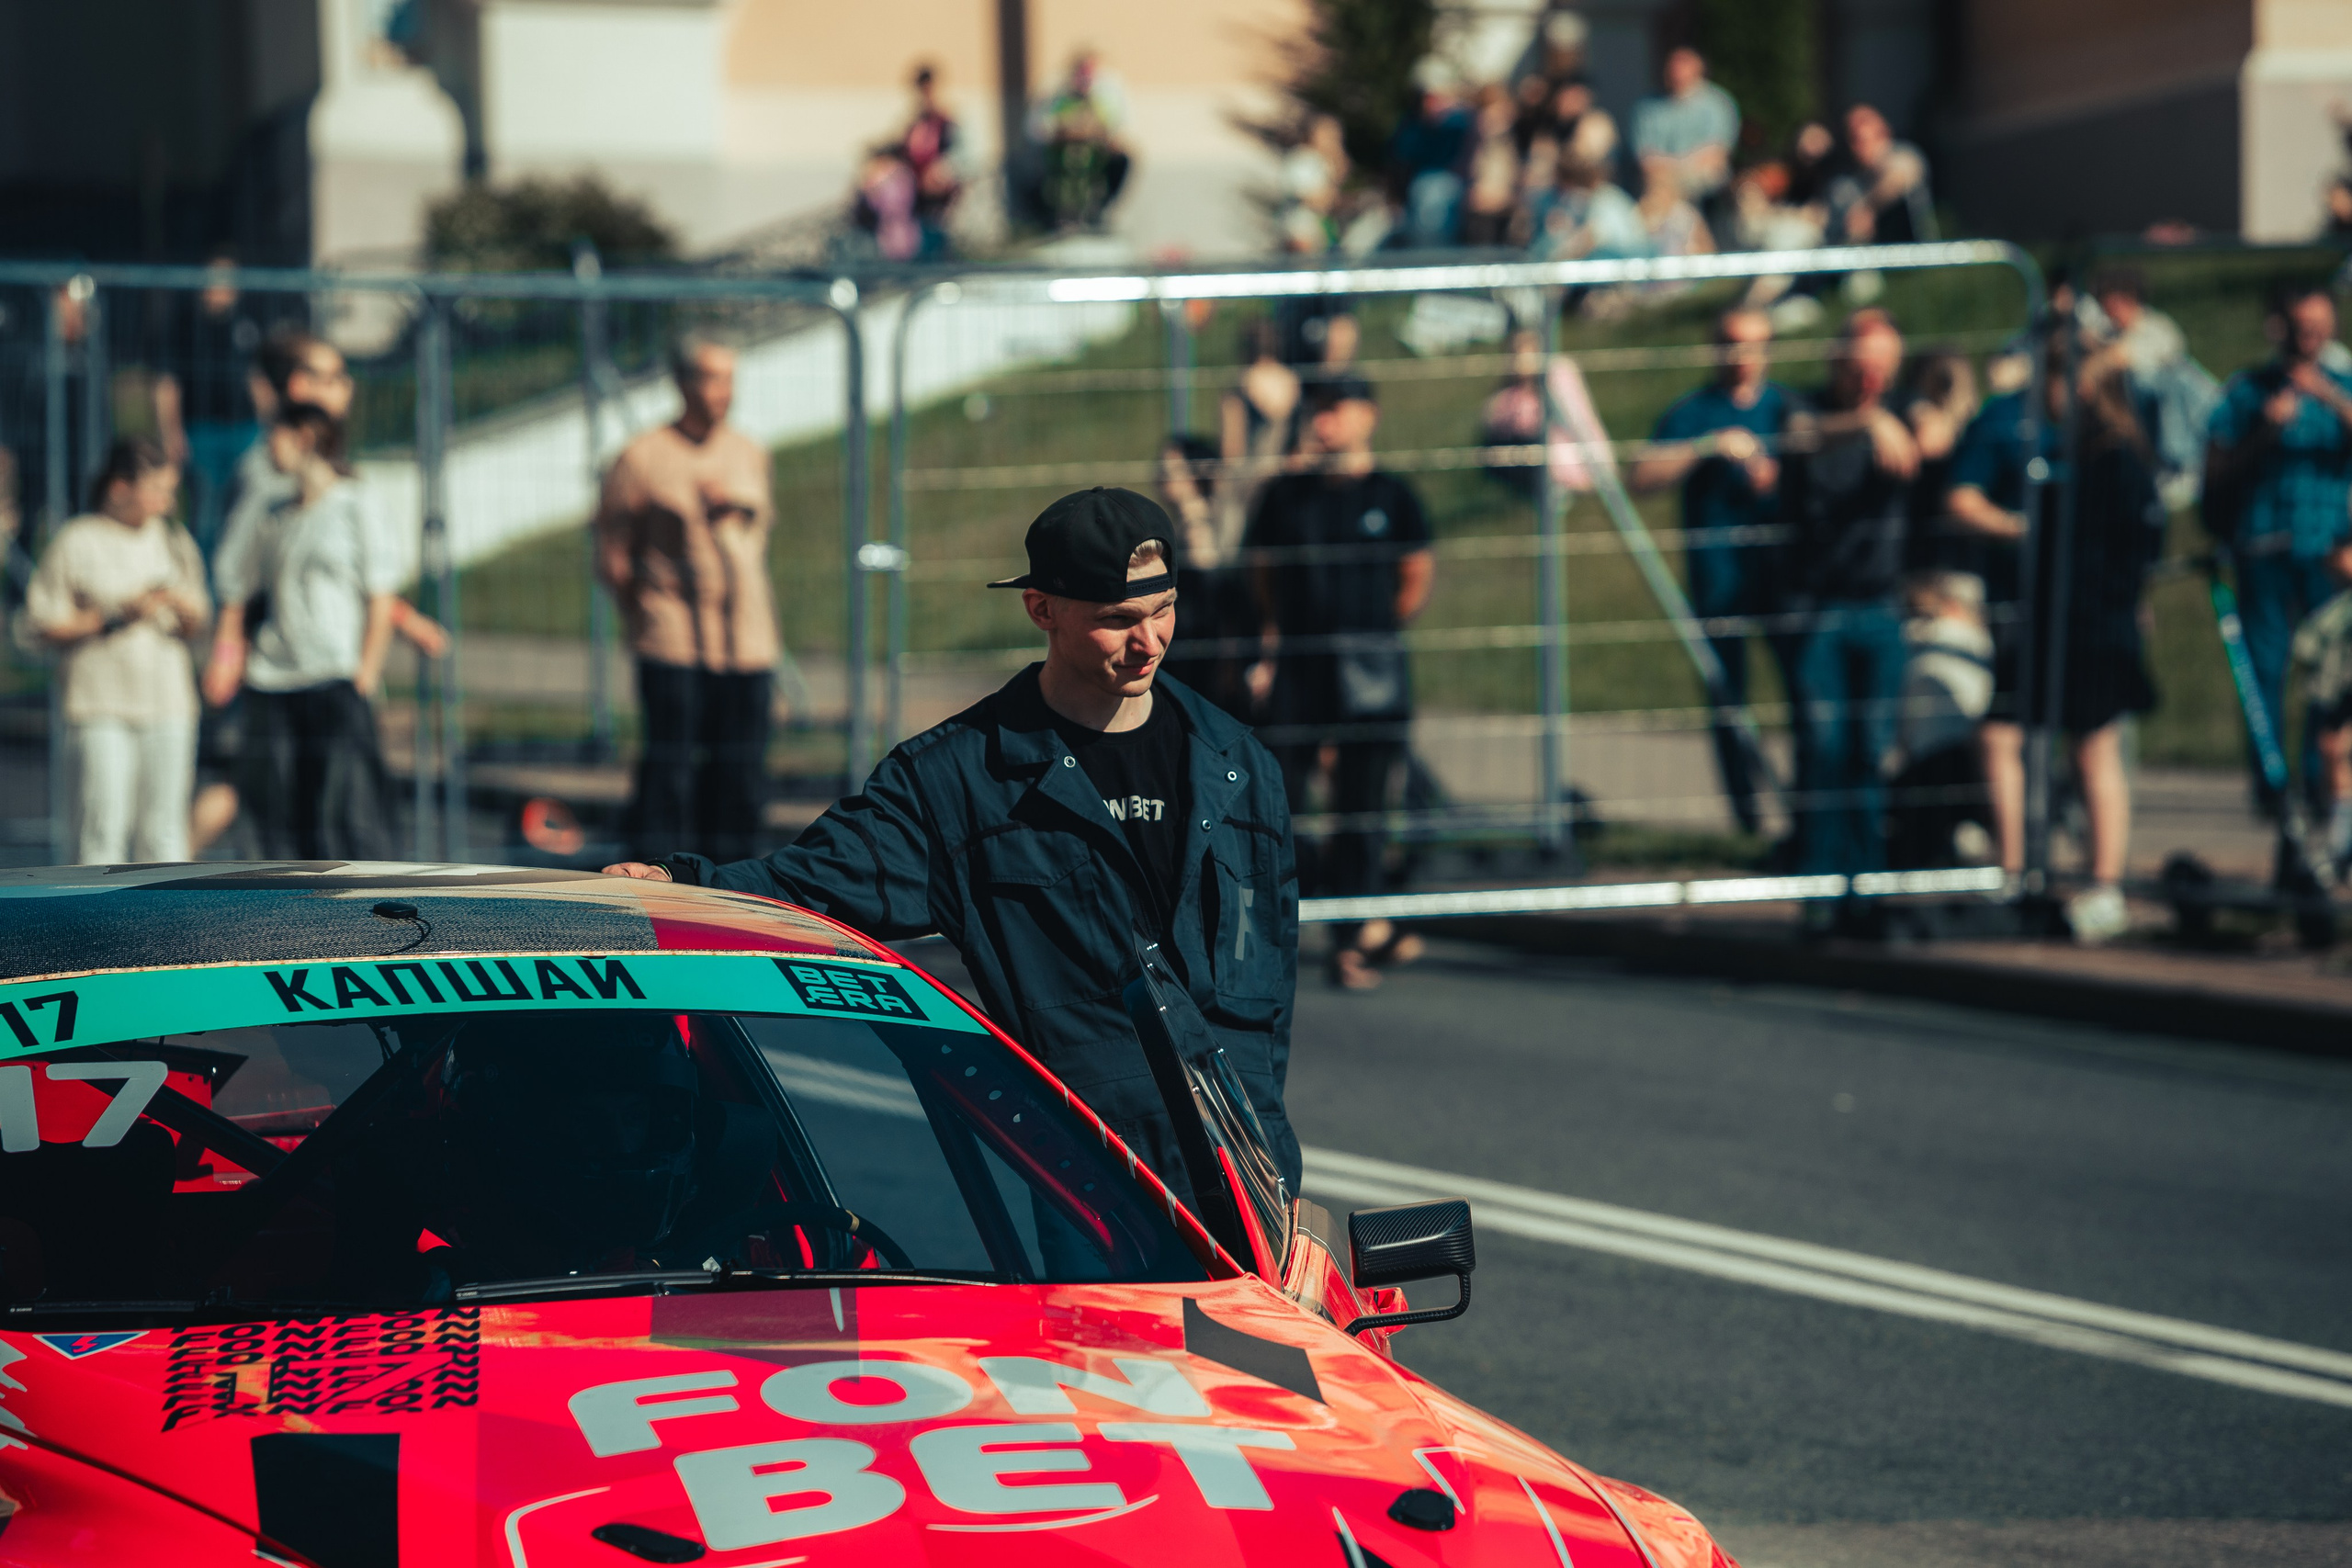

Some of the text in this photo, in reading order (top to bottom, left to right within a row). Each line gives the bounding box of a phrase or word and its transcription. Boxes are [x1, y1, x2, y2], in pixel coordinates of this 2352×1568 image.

[263, 954, 648, 1012] КАПШАЙ
[788, 964, 888, 994] BET
[0, 989, 79, 1048] 17
[0, 1060, 169, 1154] 17
[568, 1357, 1213, 1458] FON
[673, 1422, 1296, 1551] BET
